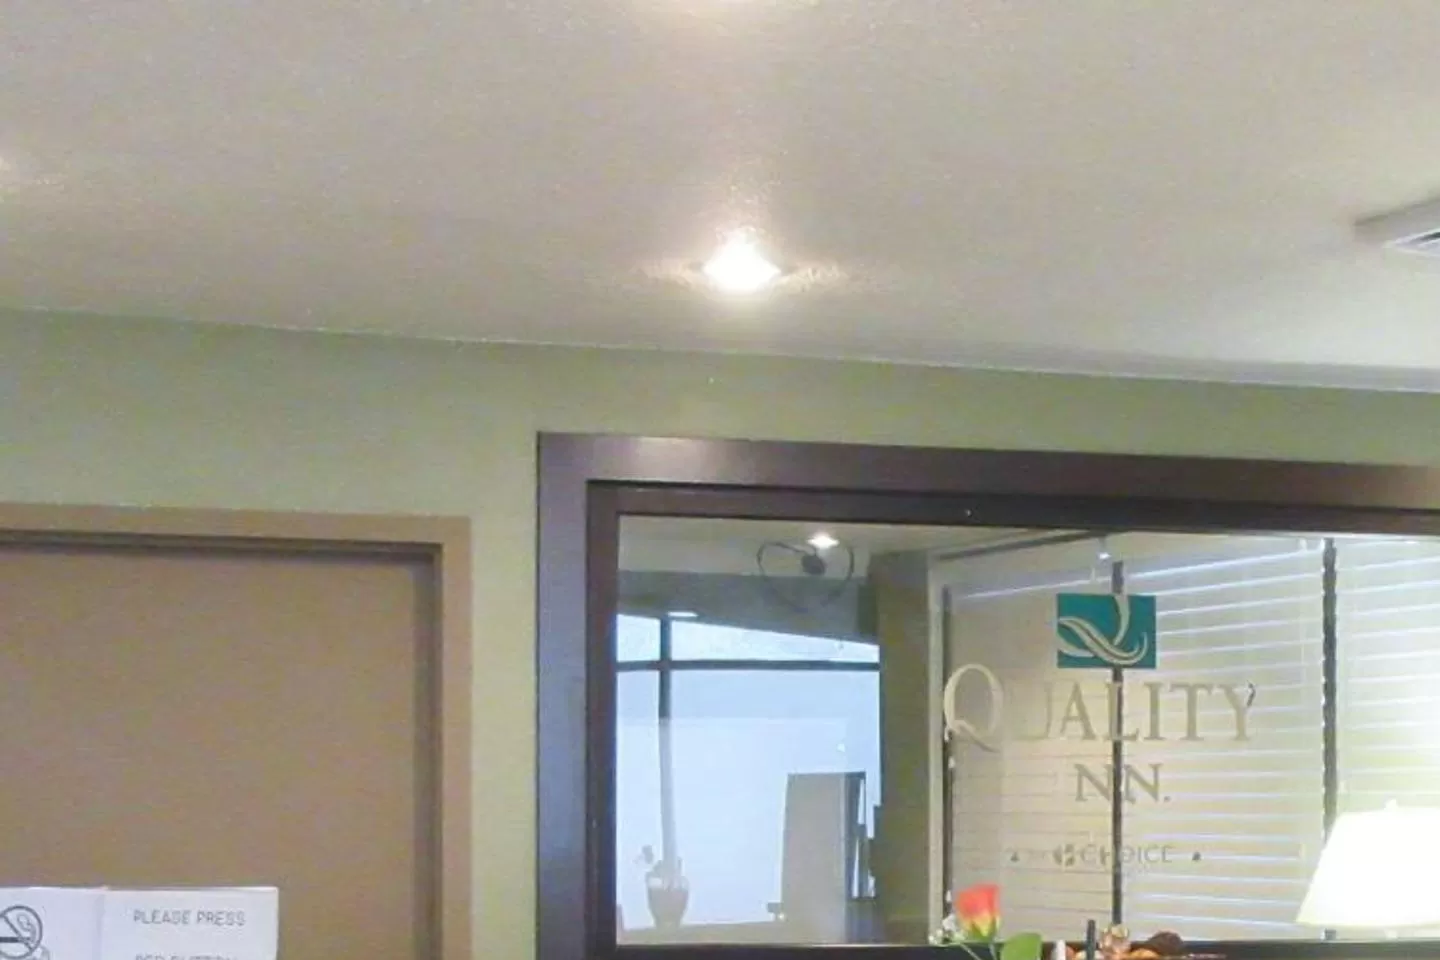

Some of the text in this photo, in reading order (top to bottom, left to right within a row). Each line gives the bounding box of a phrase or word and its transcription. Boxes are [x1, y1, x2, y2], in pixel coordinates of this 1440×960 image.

[943, 663, 1256, 753] QUALITY
[1056, 762, 1171, 803] NN.
[133, 909, 247, 926] PLEASE PRESS
